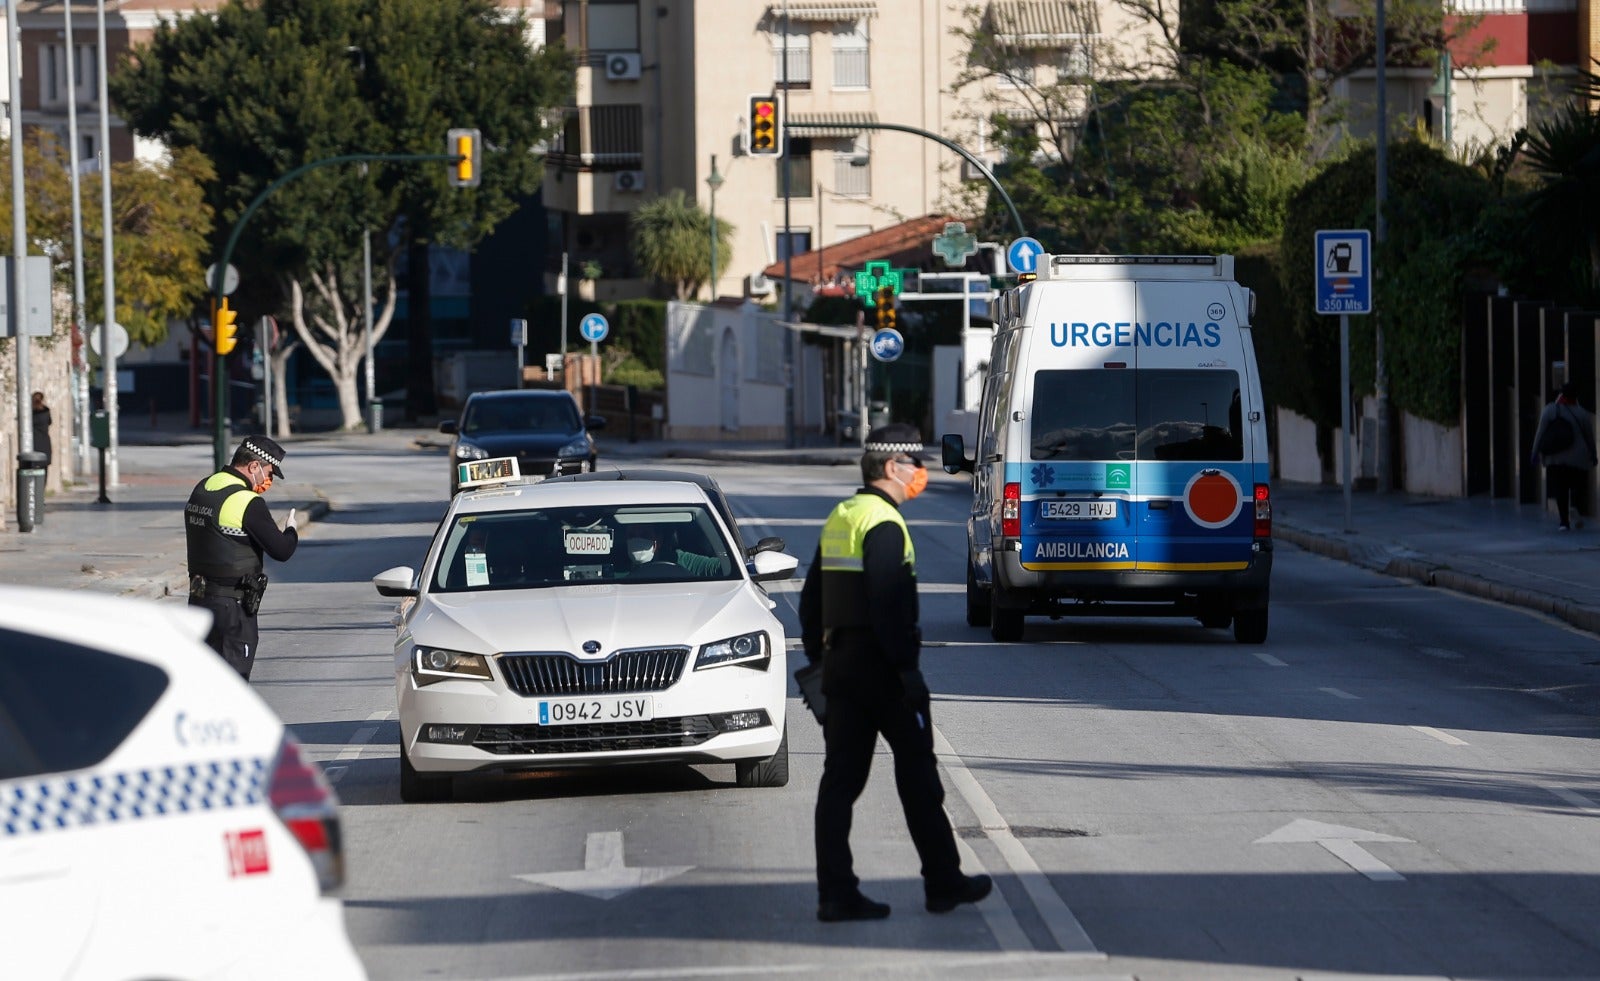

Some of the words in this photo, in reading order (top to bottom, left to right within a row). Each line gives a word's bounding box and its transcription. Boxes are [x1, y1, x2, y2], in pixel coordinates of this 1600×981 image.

[1324, 299, 1342, 311] 350
[1345, 299, 1362, 311] Mts
[1050, 322, 1221, 347] URGENCIAS
[1050, 503, 1080, 516] 5429
[1089, 503, 1112, 516] HVJ
[570, 537, 607, 551] OCUPADO
[1036, 543, 1129, 558] AMBULANCIA
[553, 702, 602, 721] 0942
[610, 700, 645, 719] JSV
